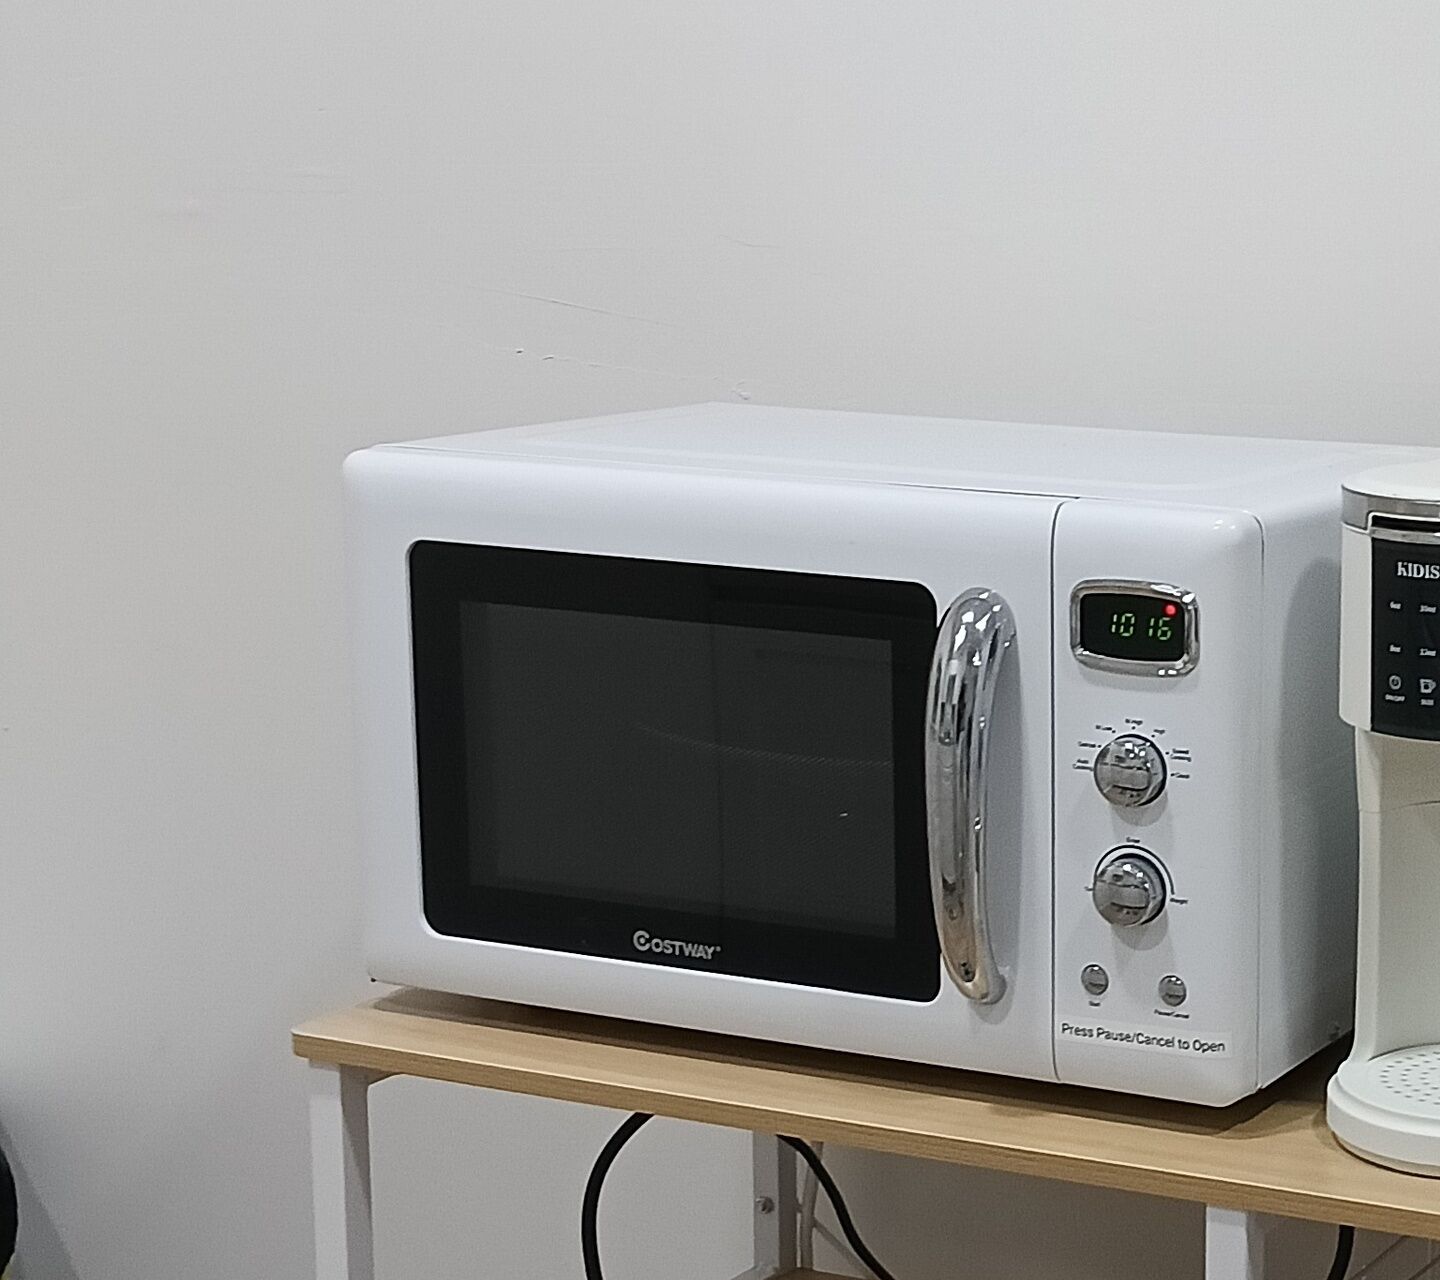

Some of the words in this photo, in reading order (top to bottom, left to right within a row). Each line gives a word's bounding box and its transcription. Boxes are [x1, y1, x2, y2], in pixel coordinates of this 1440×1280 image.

[632, 930, 716, 960] COSTWAY
[1061, 1022, 1094, 1038] Press
[1096, 1027, 1175, 1048] Pause/Cancel
[1177, 1038, 1191, 1051] to
[1192, 1039, 1227, 1054] Open
